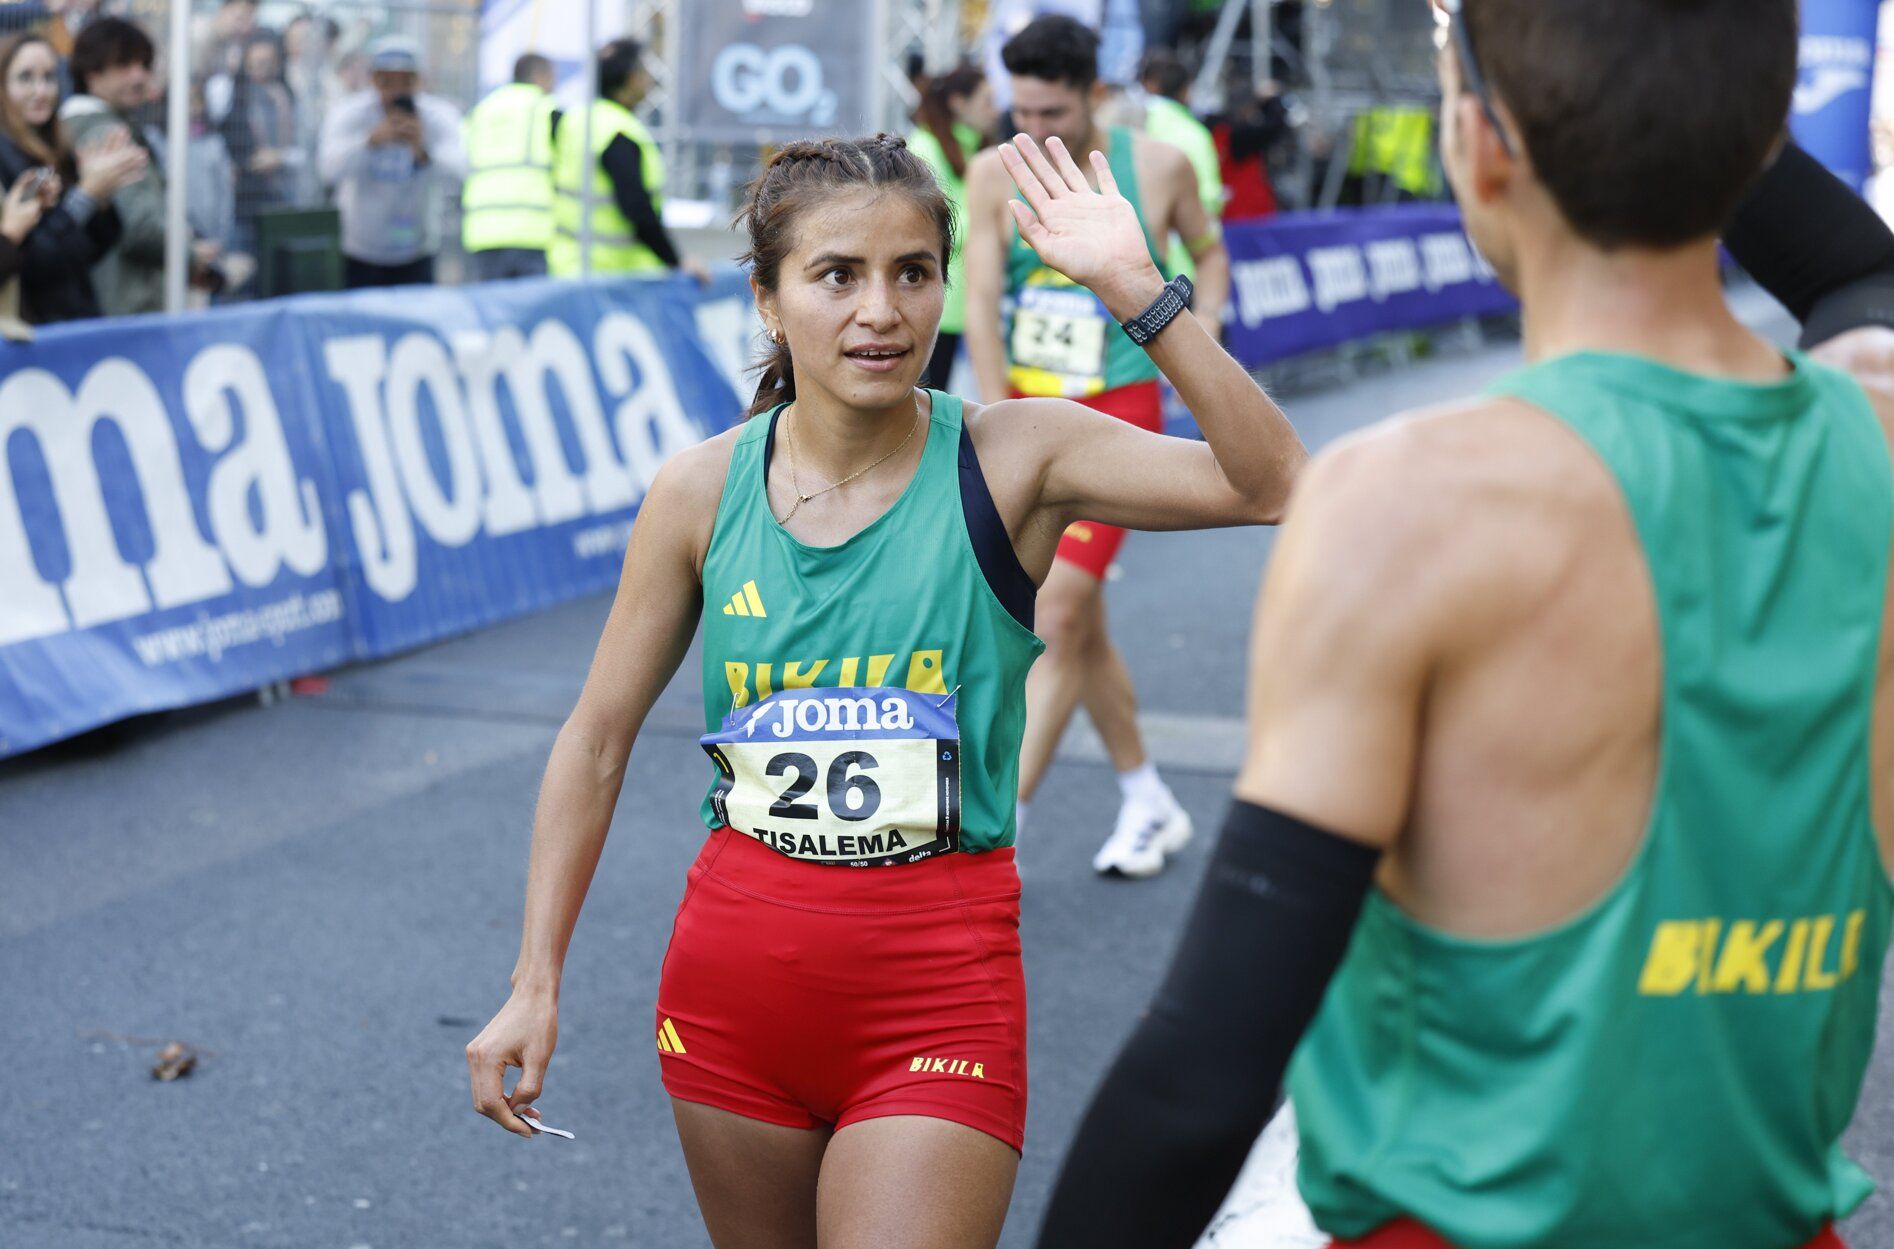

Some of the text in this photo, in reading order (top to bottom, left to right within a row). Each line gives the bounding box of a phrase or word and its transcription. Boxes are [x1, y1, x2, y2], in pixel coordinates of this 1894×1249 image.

[772, 697, 914, 738] Joma
[765, 750, 881, 821] 26
[753, 825, 907, 857] TISALEMA
[908, 1056, 985, 1079] BIKILA
